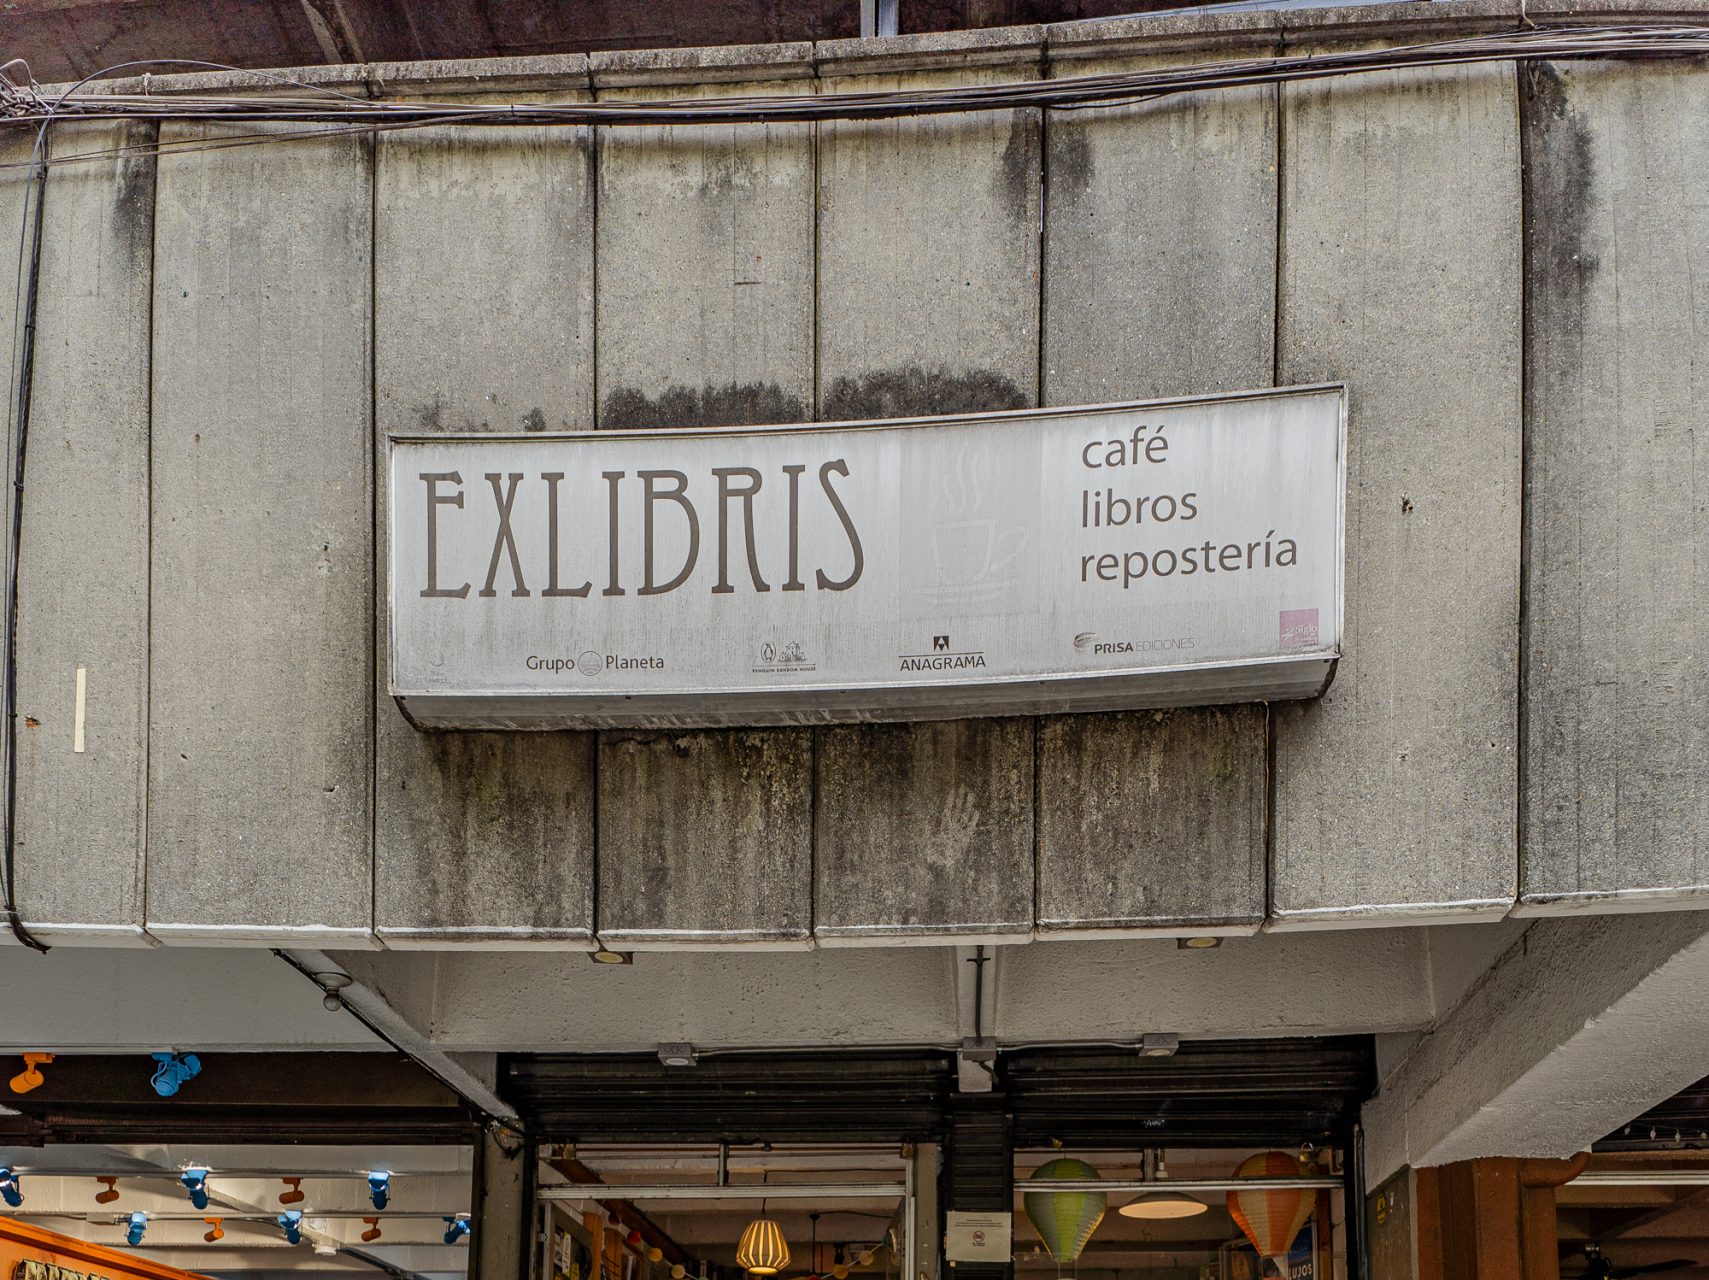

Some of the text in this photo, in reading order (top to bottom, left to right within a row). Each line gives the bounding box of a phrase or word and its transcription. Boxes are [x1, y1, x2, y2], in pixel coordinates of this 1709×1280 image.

[1082, 425, 1169, 469] café
[1082, 488, 1198, 528] libros
[419, 458, 864, 599] EXLIBRIS
[1081, 529, 1297, 589] repostería
[526, 655, 665, 674] Grupo Planeta
[899, 655, 986, 672] ANAGRAMA
[1094, 637, 1195, 655] PRISA EDICIONES
